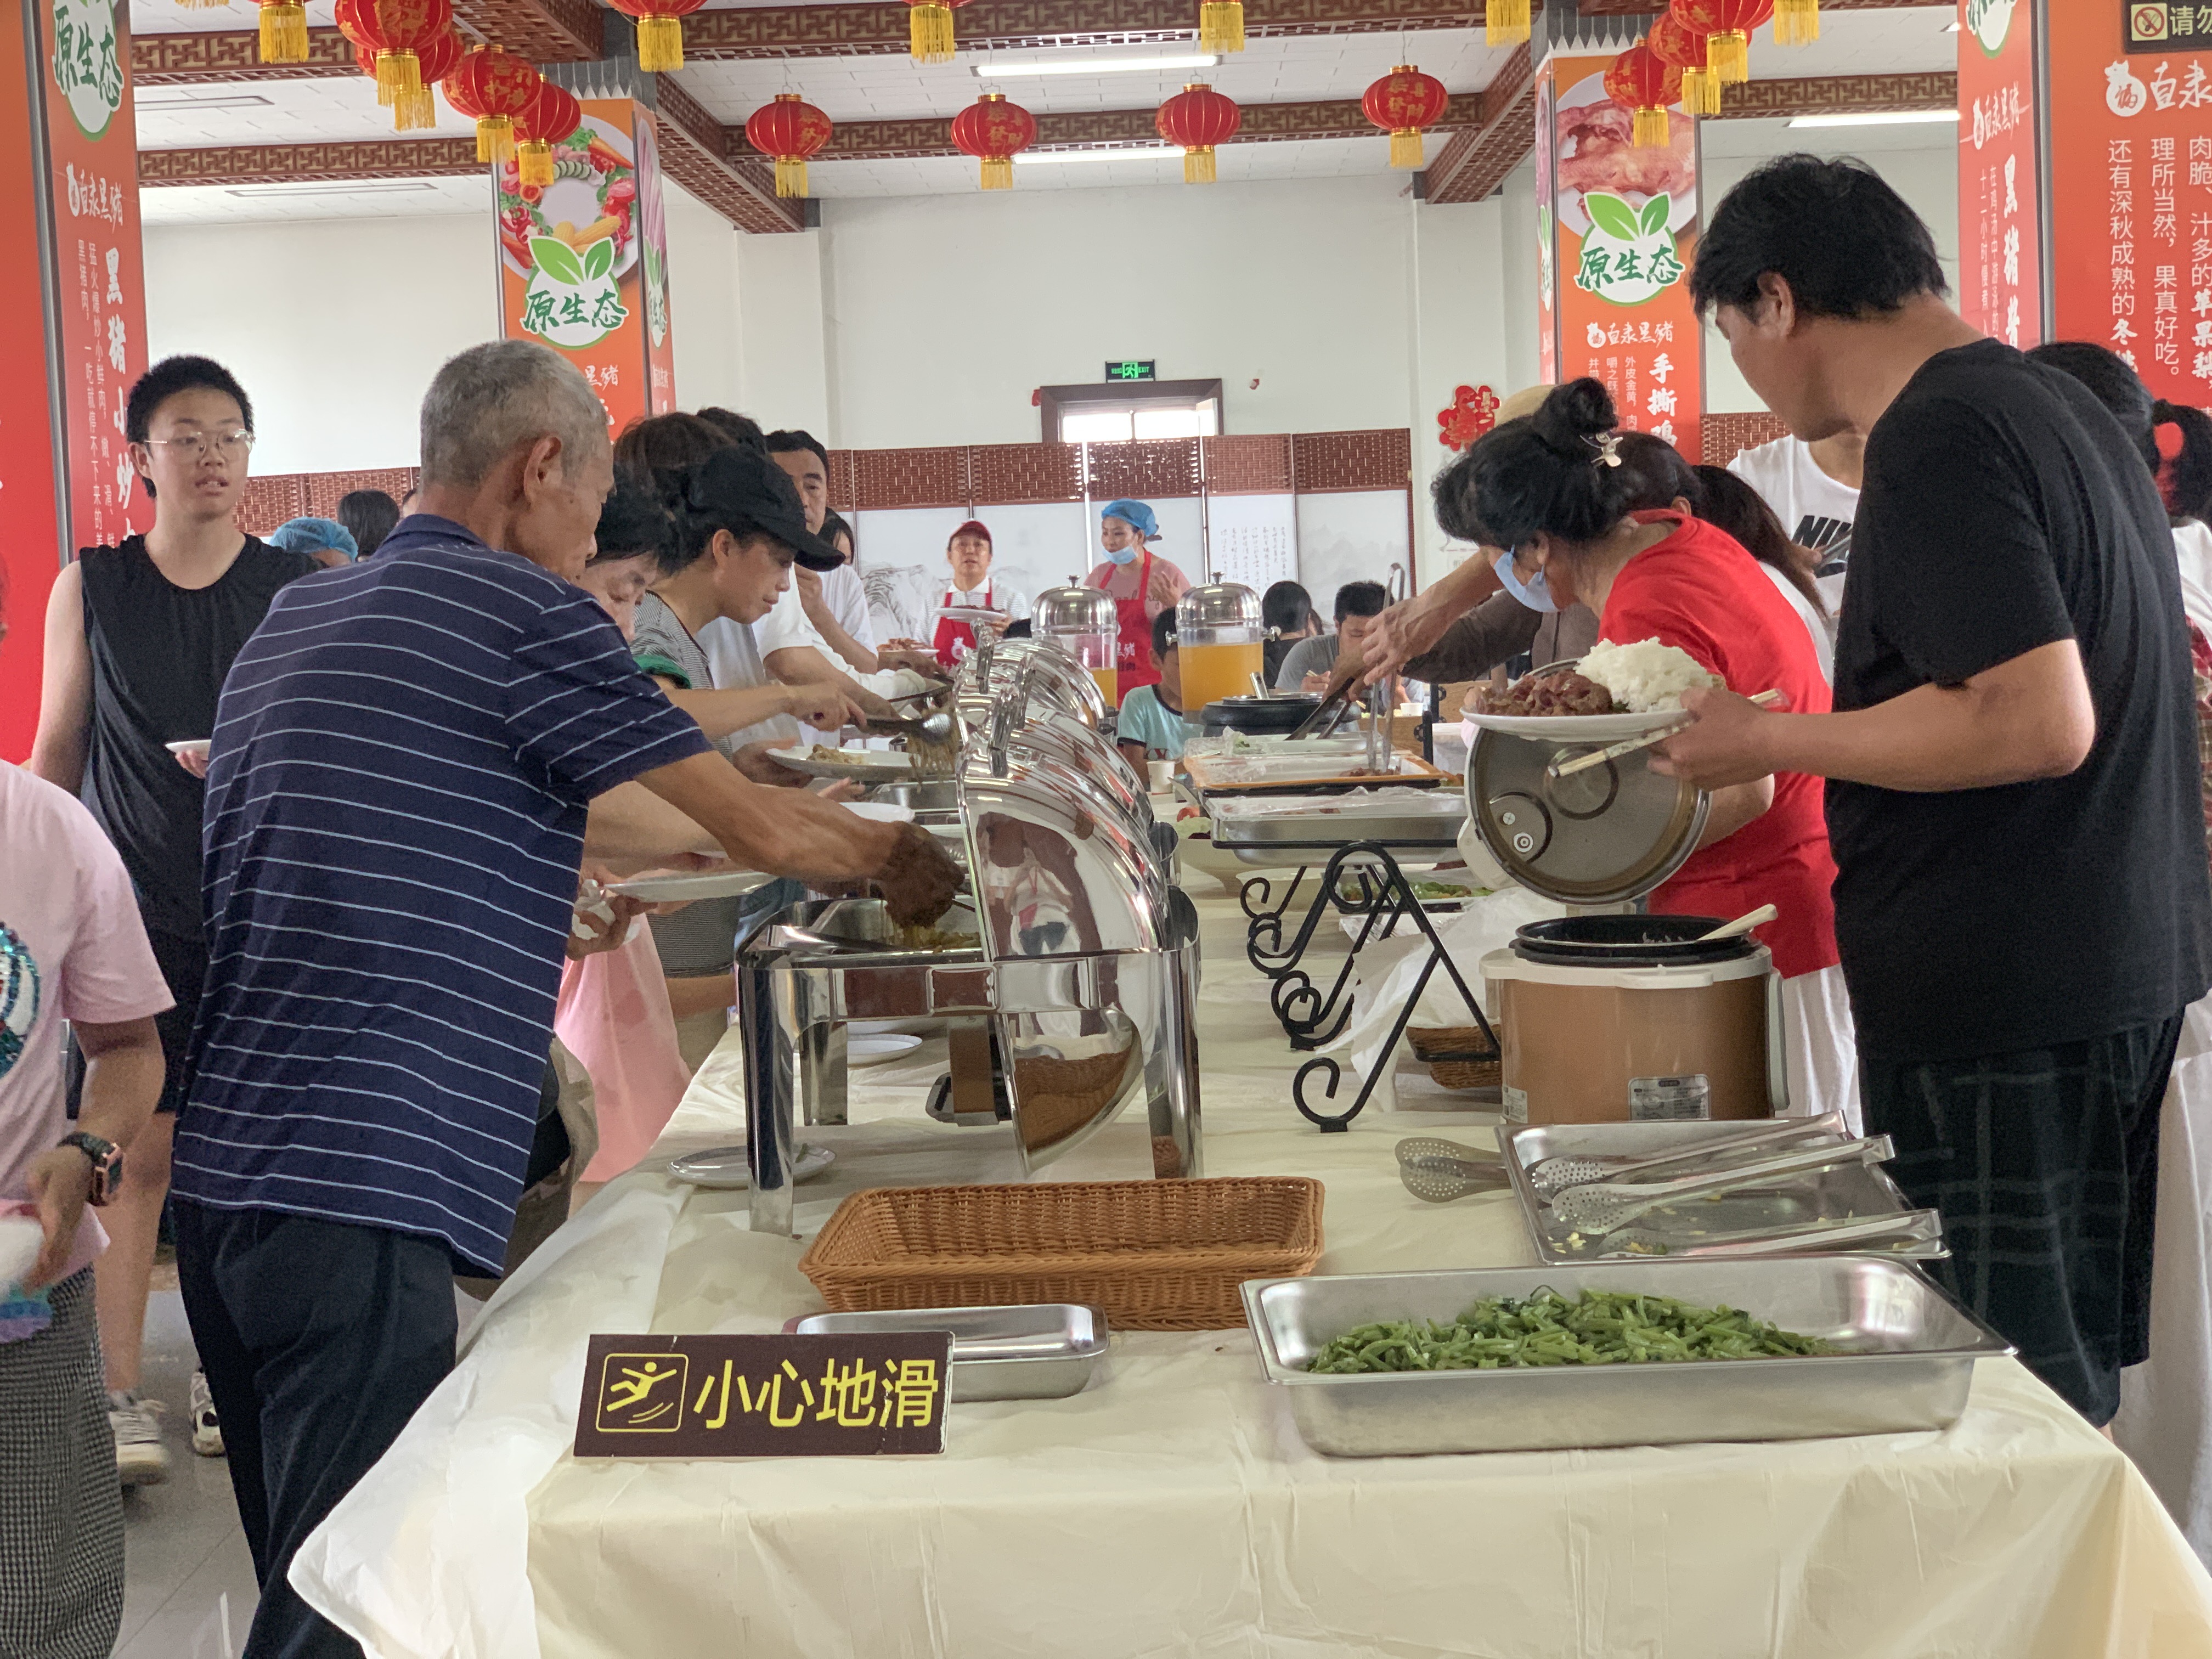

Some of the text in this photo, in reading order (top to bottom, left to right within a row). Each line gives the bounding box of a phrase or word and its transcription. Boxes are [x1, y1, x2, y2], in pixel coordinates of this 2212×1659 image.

[54, 5, 123, 108] 原生态
[1578, 245, 1683, 289] 原生态
[524, 289, 627, 331] 原生态
[106, 247, 136, 541] 黑猪小炒
[693, 1358, 938, 1429] 小心地滑
